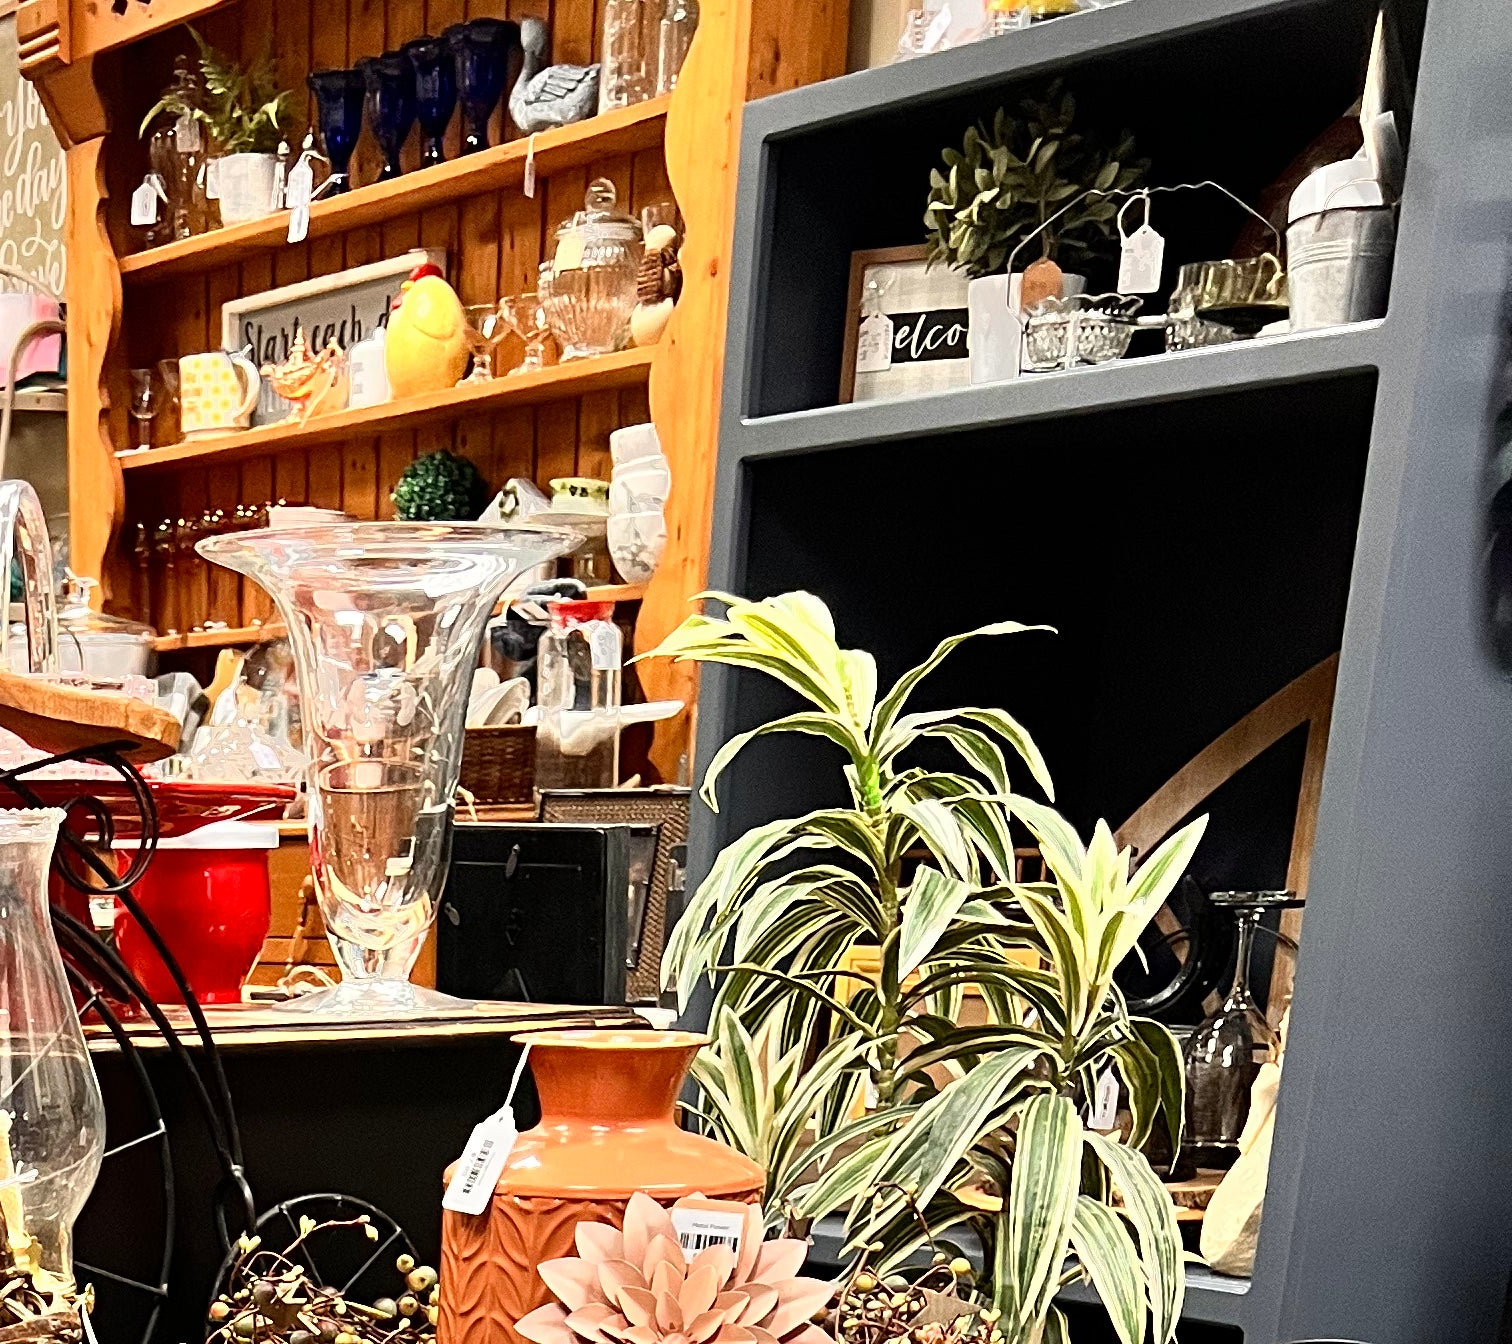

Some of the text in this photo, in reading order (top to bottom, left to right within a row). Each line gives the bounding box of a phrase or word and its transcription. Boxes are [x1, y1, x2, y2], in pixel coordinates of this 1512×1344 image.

[16, 141, 67, 230] day
[311, 304, 363, 356] each
[892, 313, 969, 359] elco
